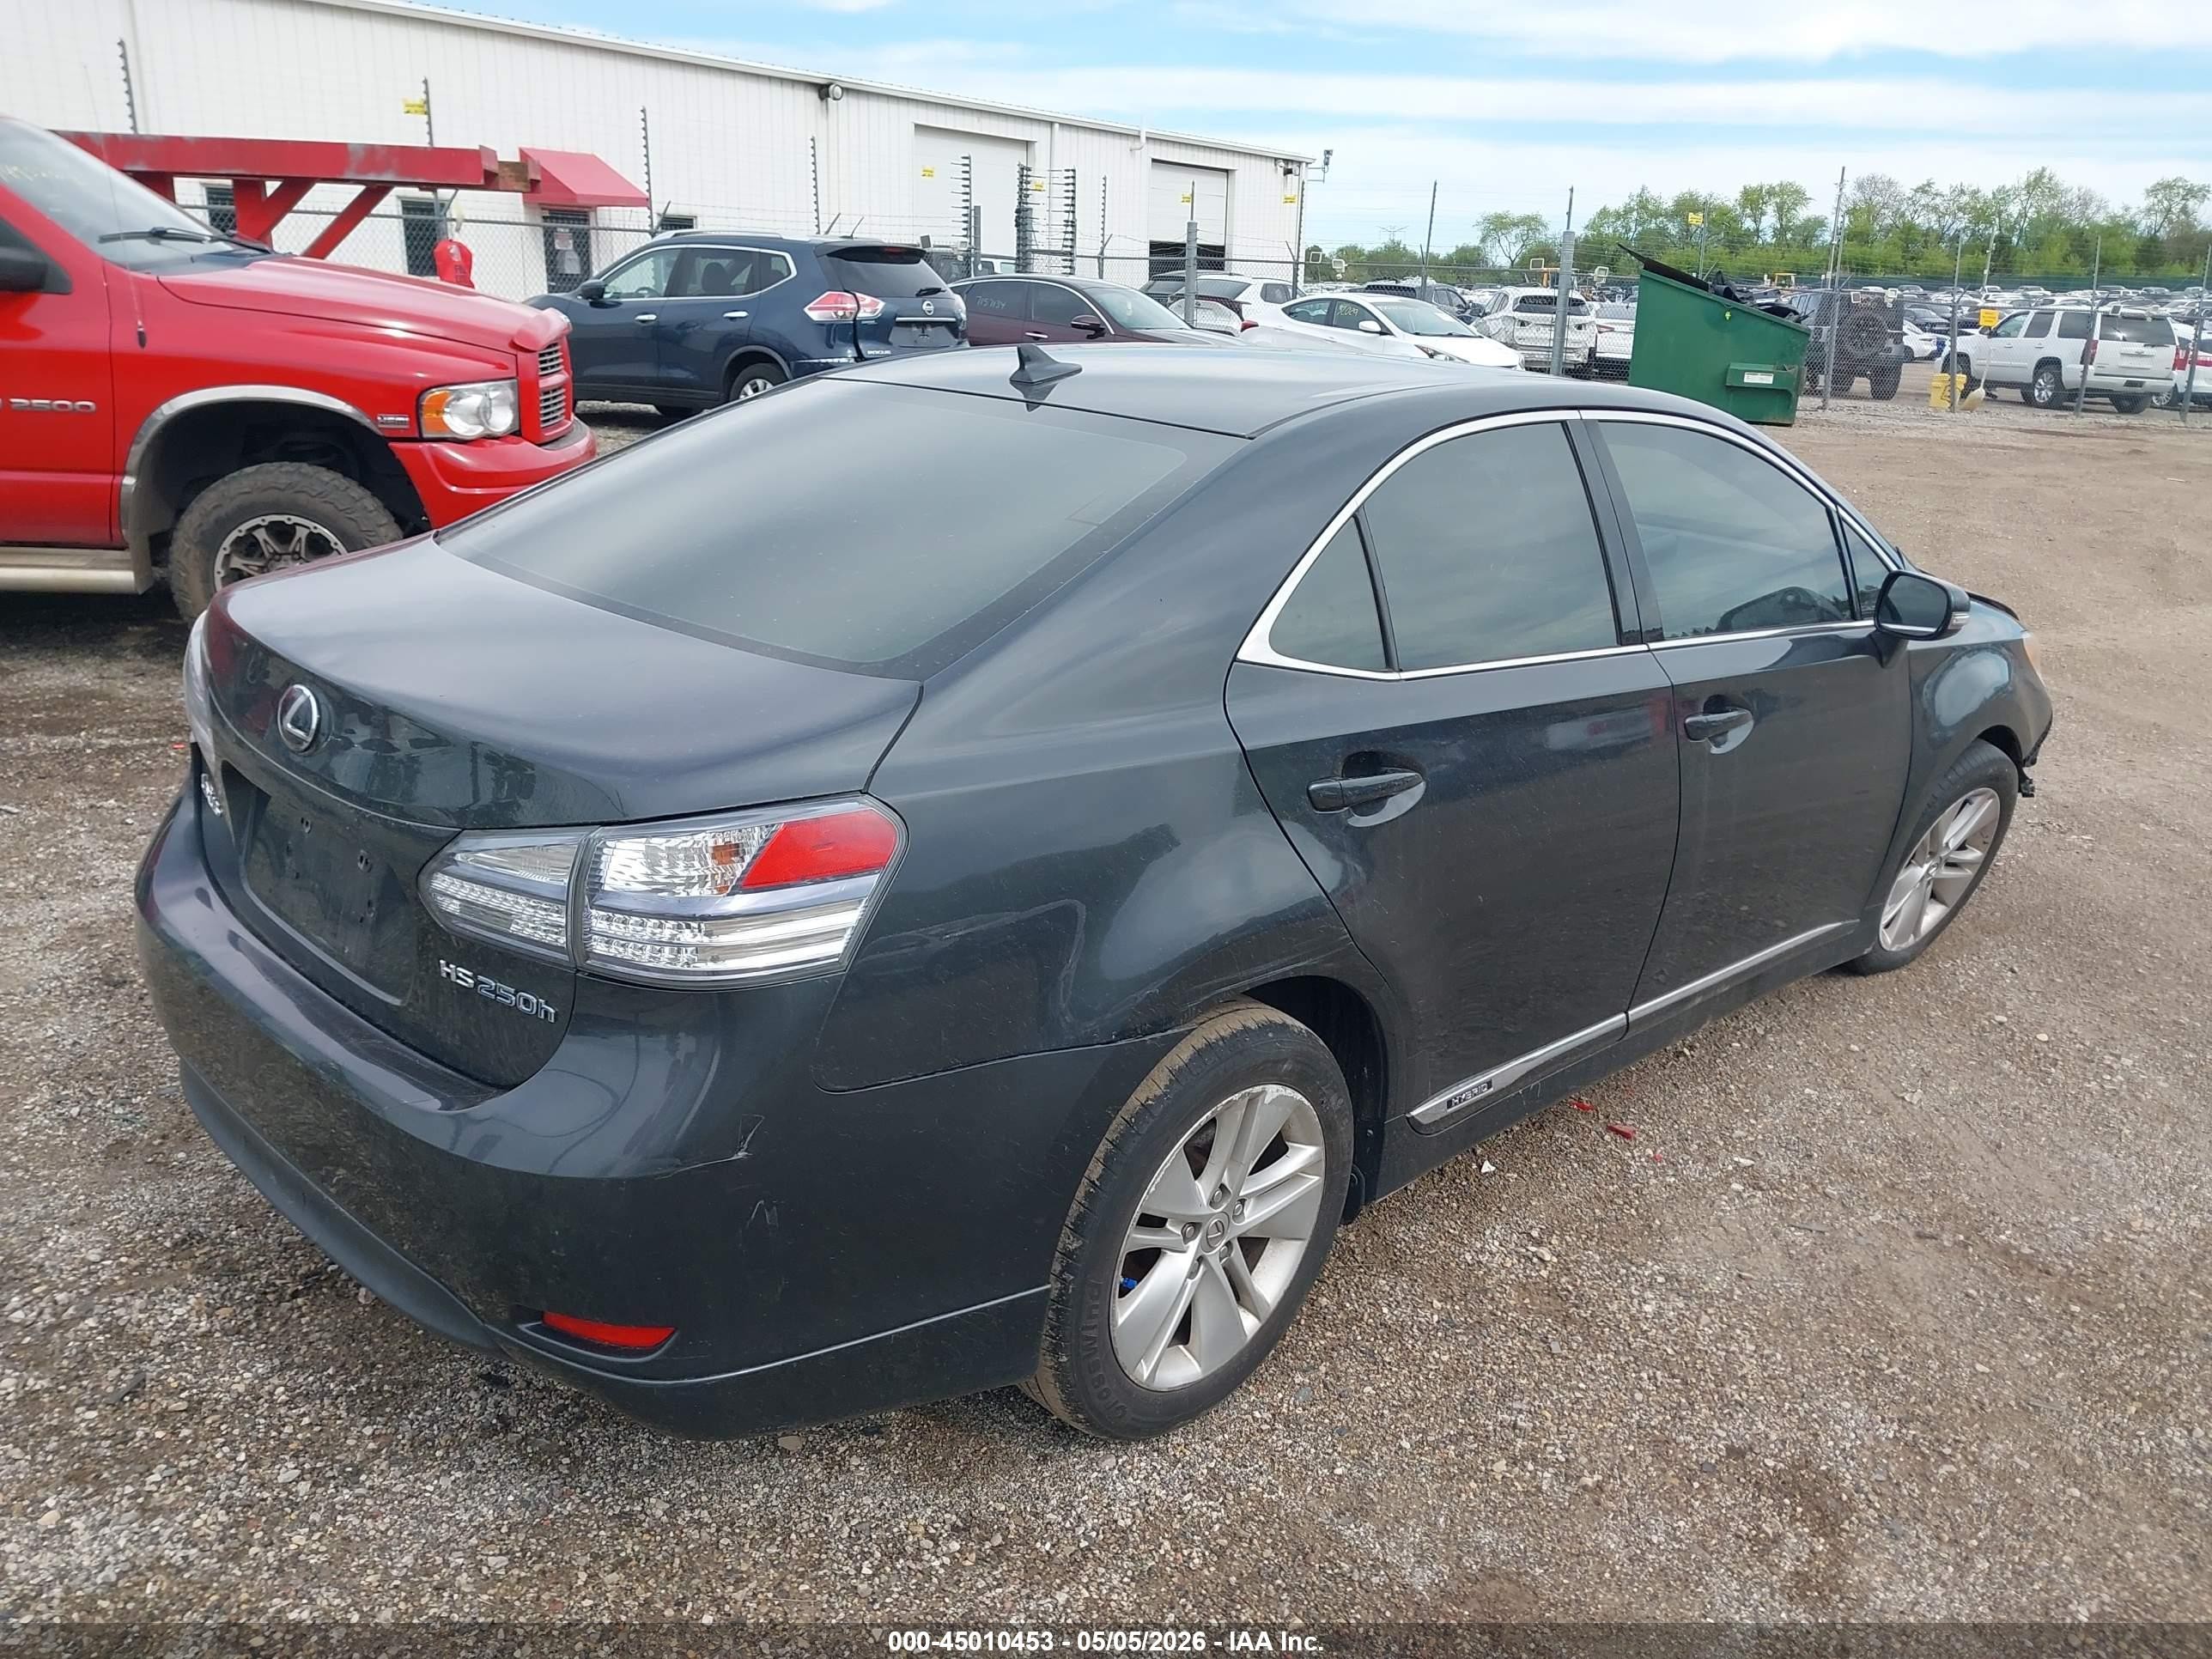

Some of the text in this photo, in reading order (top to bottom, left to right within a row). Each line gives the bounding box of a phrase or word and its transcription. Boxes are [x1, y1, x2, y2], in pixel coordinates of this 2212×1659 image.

[9, 397, 97, 414] 2500
[439, 959, 556, 1024] HS 250h
[1451, 1082, 1489, 1107] HYBRID
